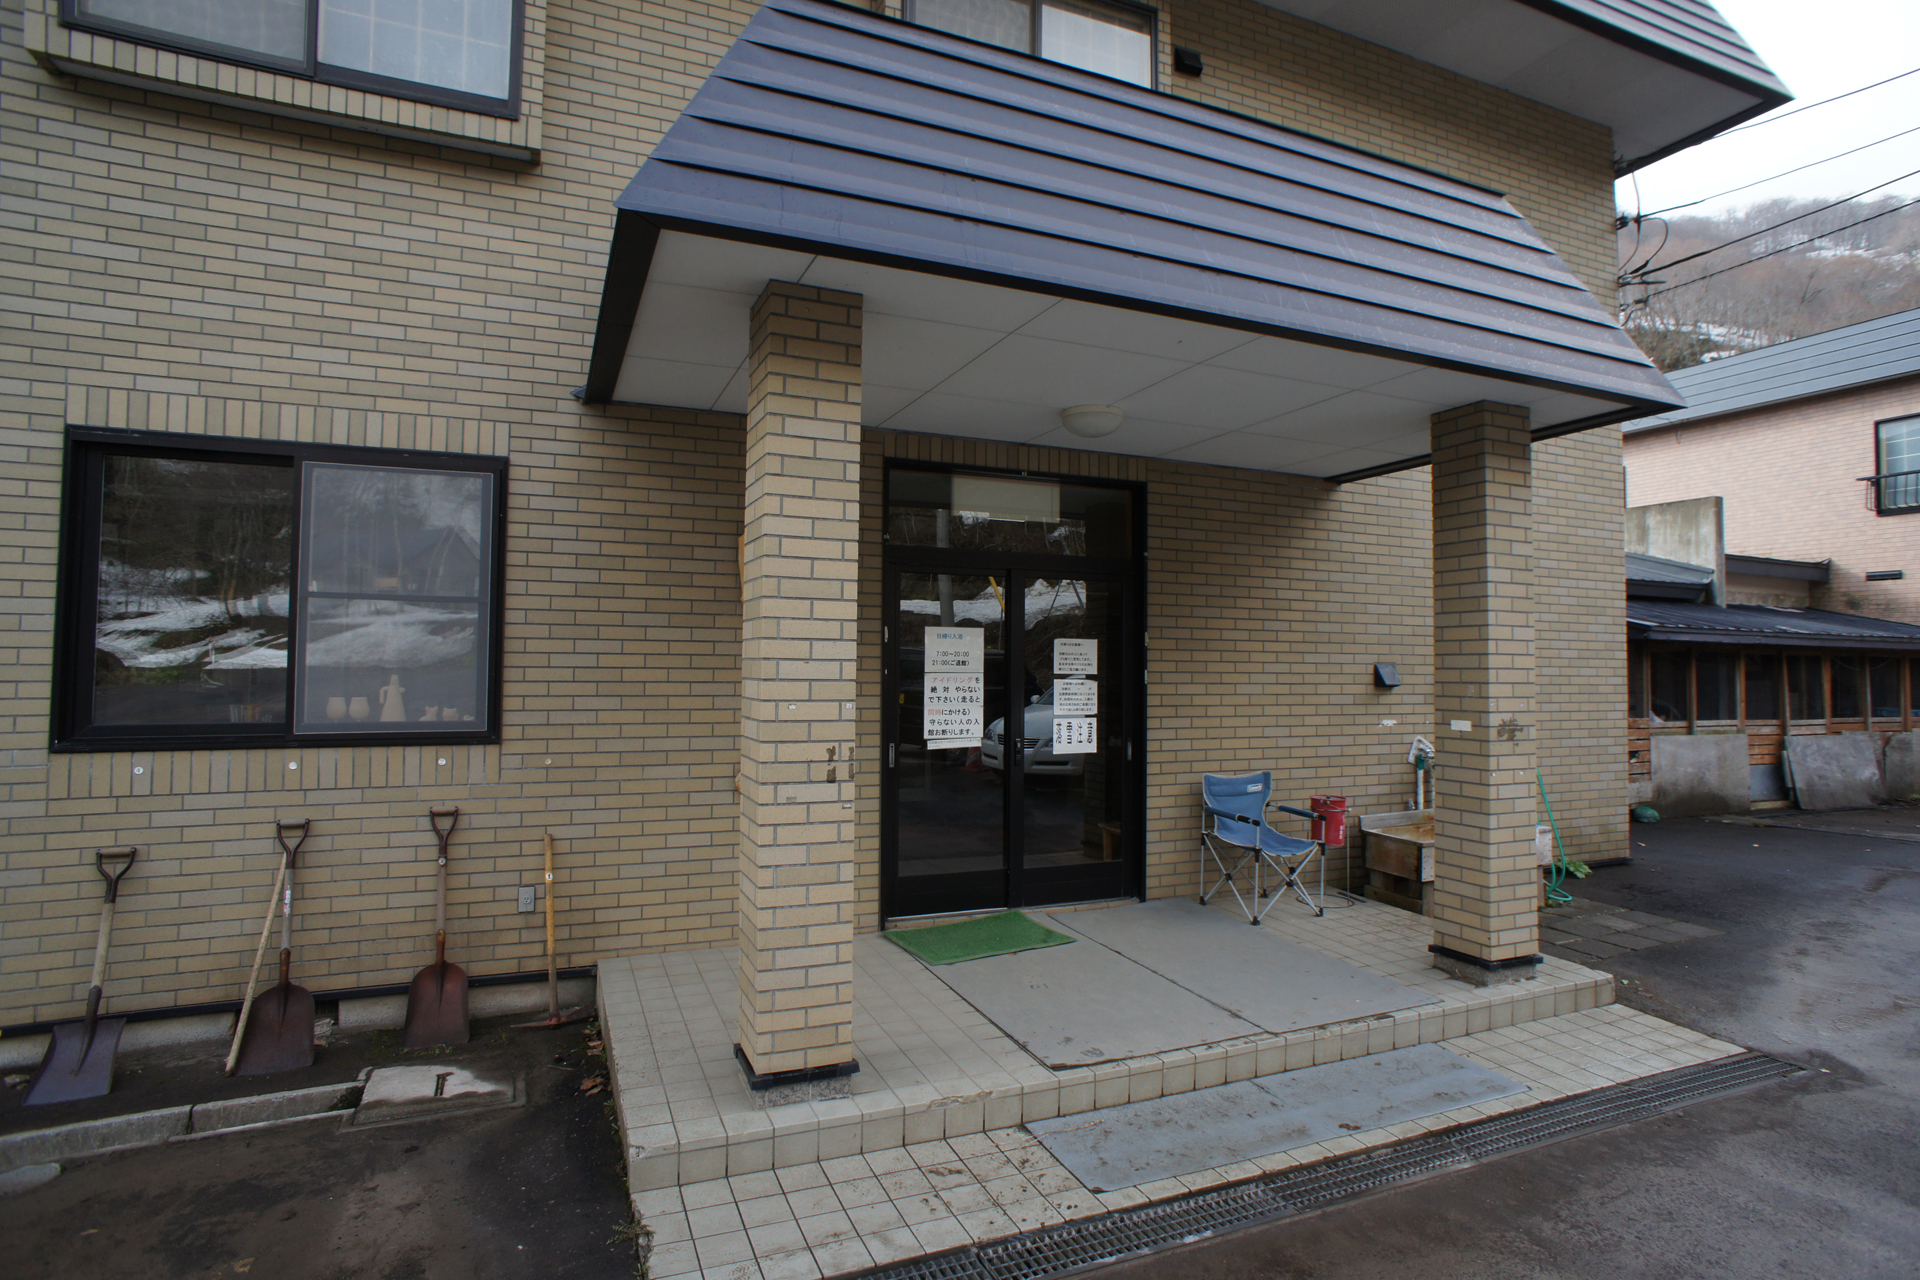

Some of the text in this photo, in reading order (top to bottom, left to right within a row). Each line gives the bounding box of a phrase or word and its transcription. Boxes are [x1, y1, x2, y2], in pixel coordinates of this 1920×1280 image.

[931, 676, 981, 684] アイドリングを
[928, 695, 981, 704] で下さい（走ると
[929, 718, 980, 727] 守らない人の入
[927, 728, 975, 737] 館お断りします。
